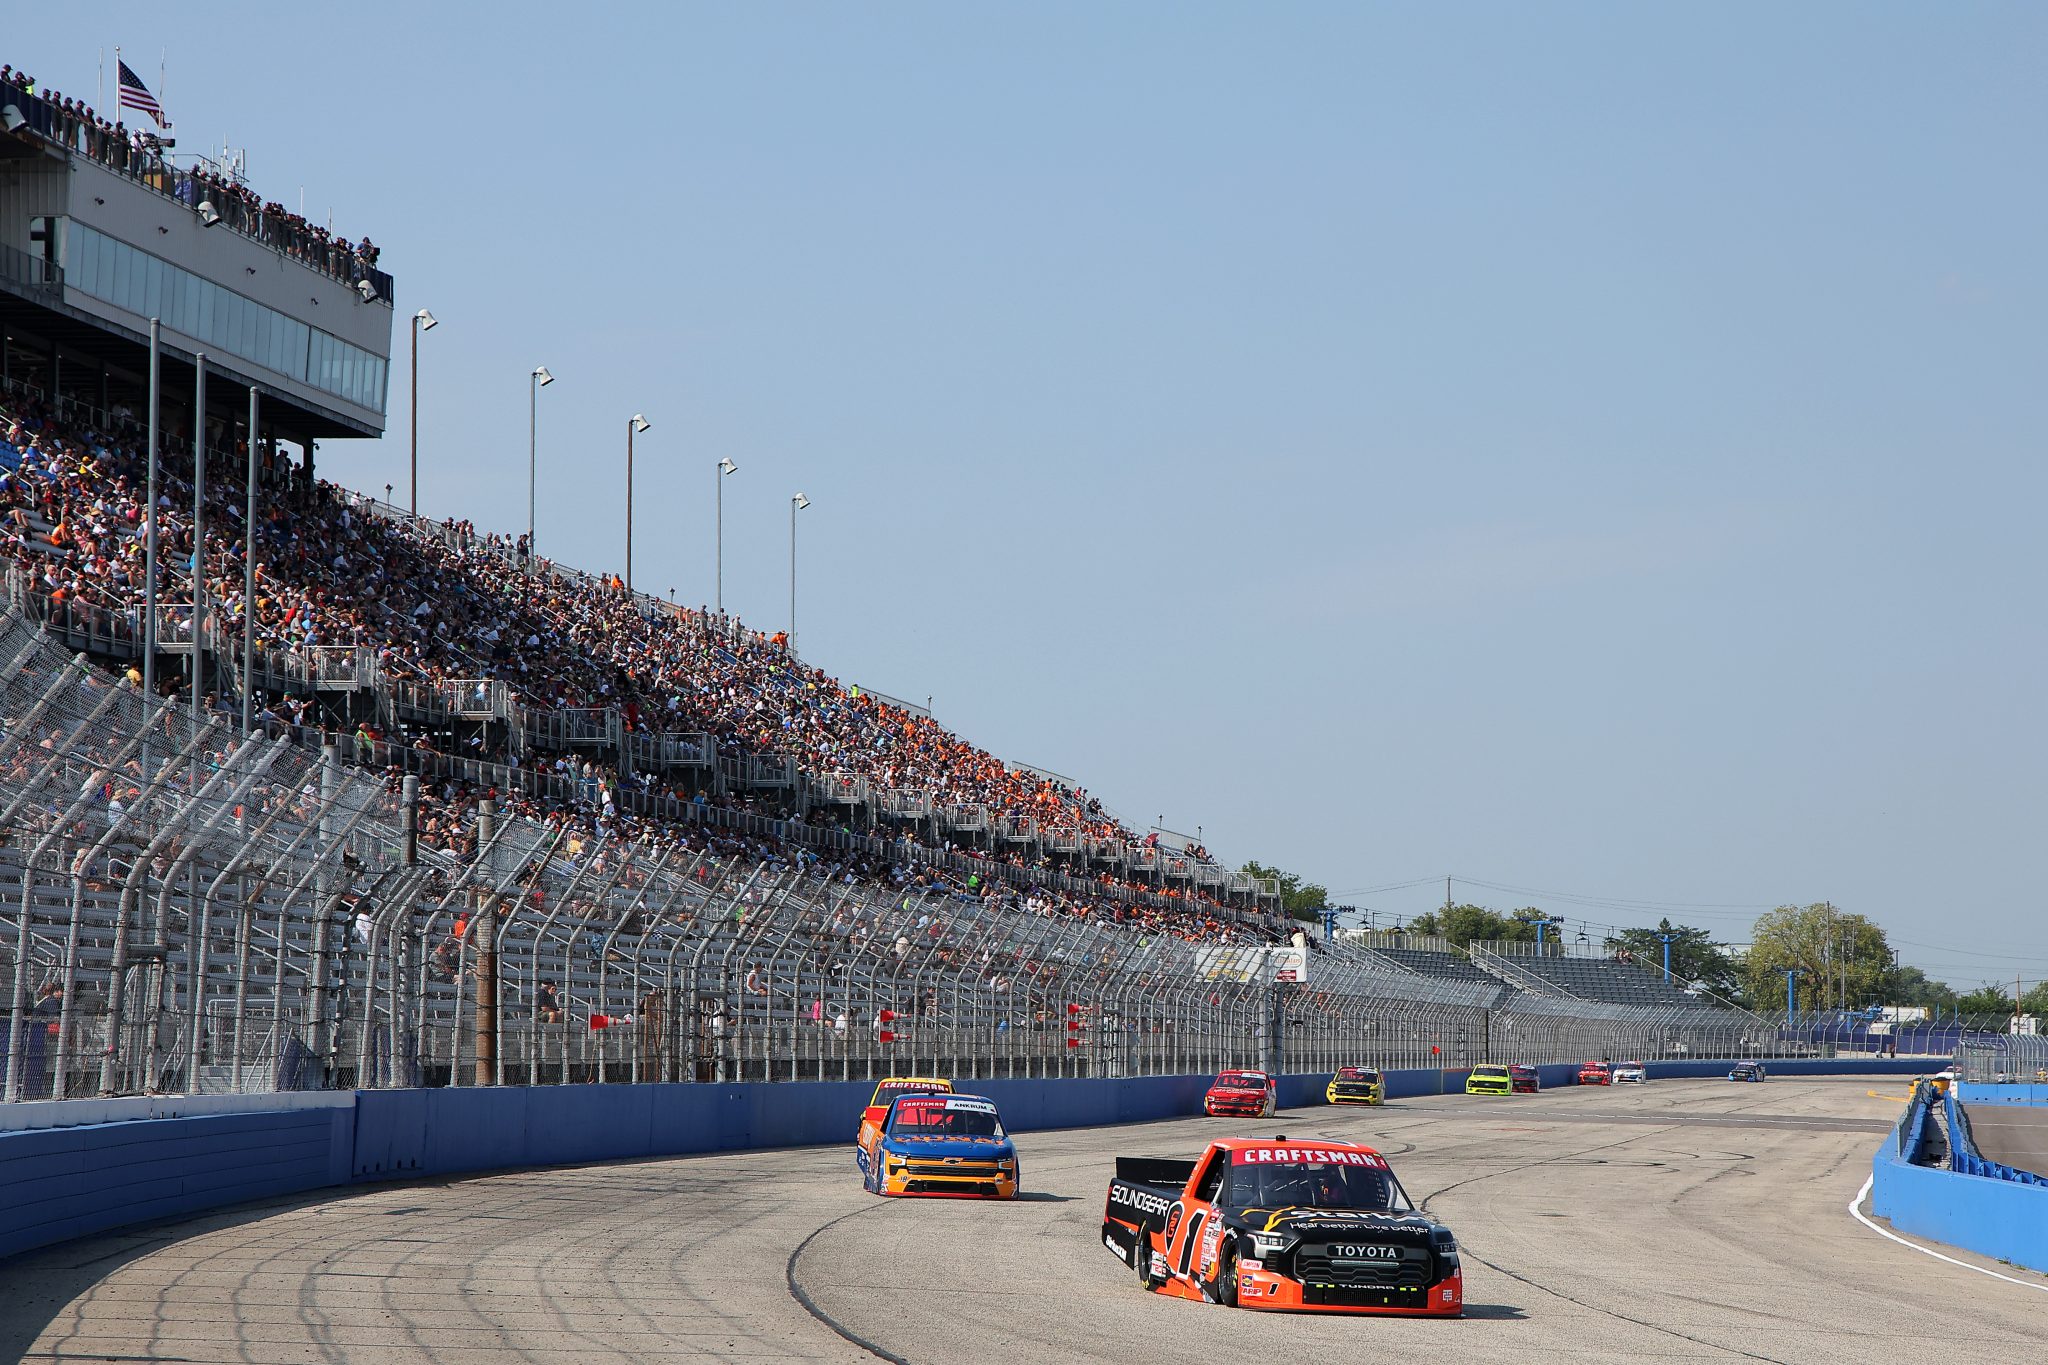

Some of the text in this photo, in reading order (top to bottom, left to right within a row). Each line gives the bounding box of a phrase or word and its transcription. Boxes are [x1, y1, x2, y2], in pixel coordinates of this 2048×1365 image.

[884, 1082, 945, 1092] CRAFTSMAN
[953, 1102, 988, 1111] ANKRUM
[1244, 1149, 1379, 1167] CRAFTSMAN
[1110, 1184, 1170, 1217] SOUNDGEAR
[1290, 1222, 1318, 1230] Hear
[1363, 1223, 1390, 1231] Live
[1336, 1245, 1397, 1258] TOYOTA
[1267, 1283, 1280, 1295] 1
